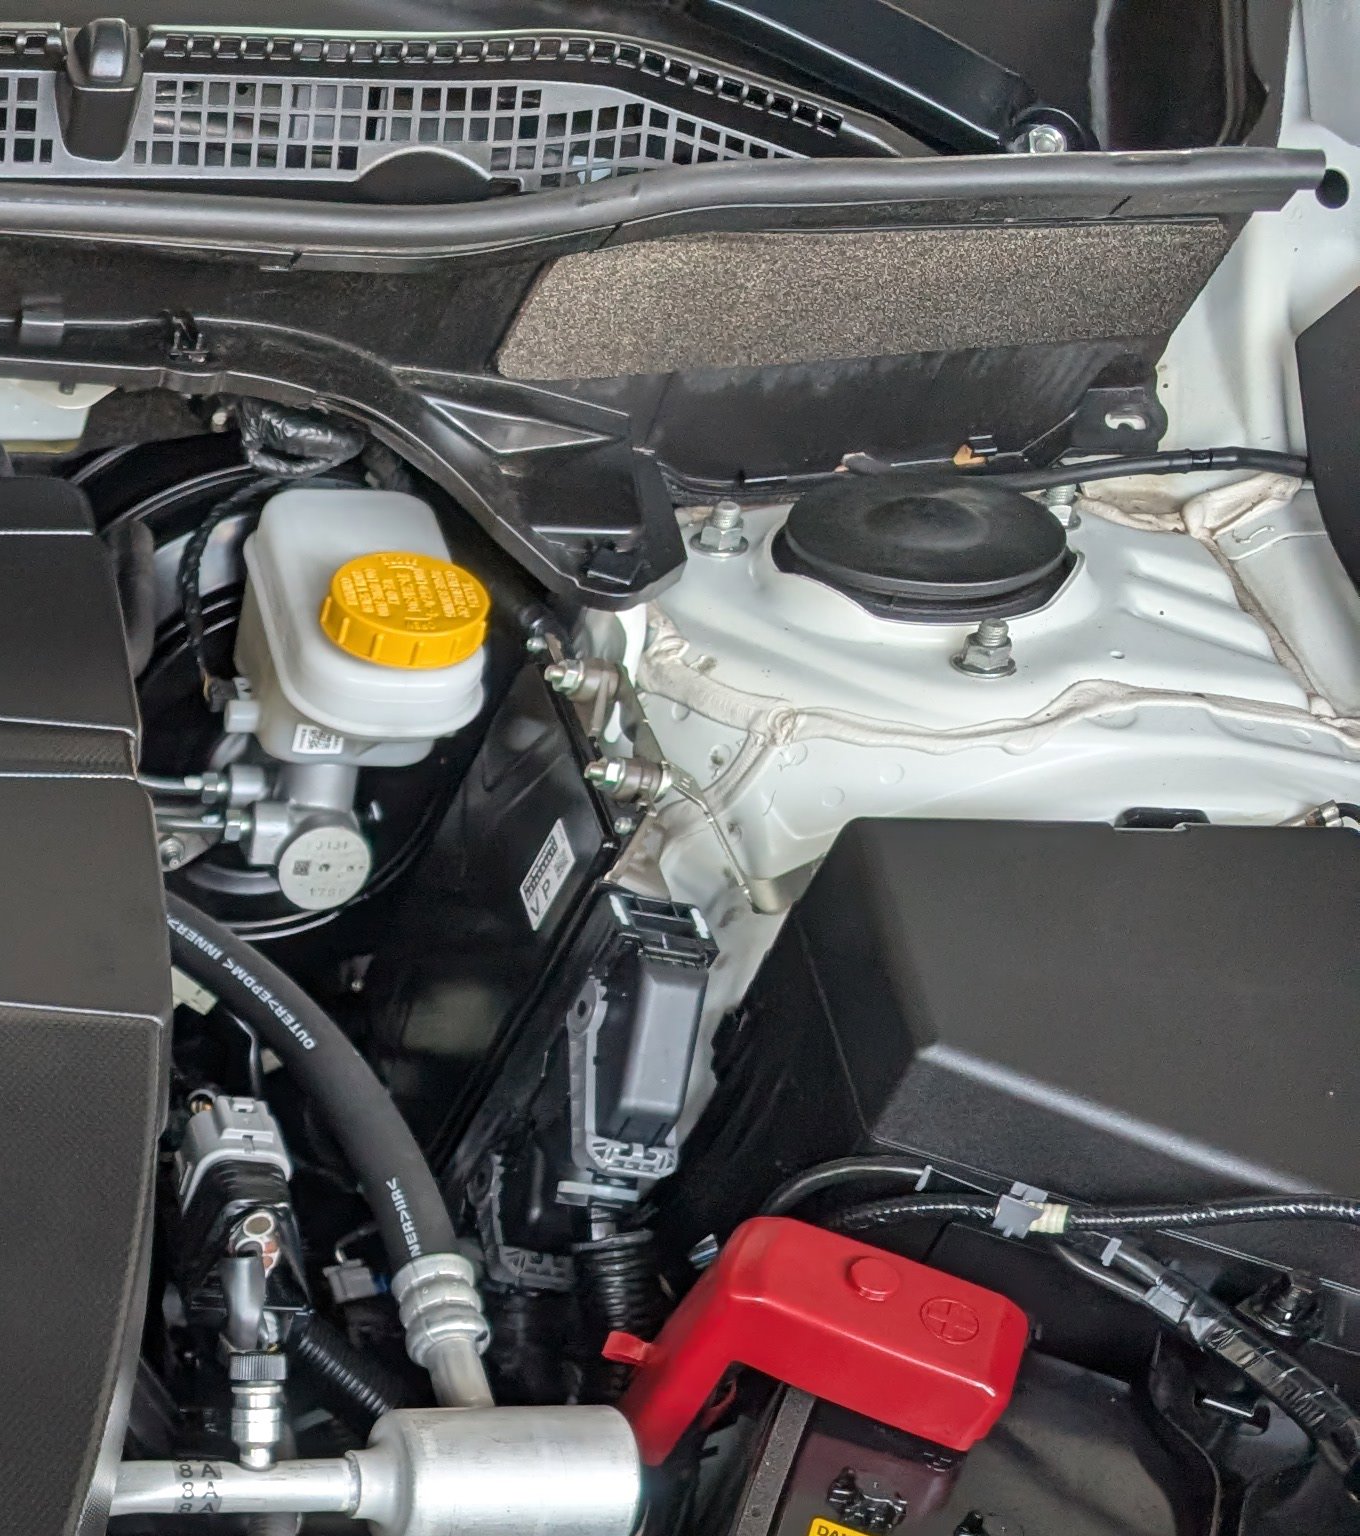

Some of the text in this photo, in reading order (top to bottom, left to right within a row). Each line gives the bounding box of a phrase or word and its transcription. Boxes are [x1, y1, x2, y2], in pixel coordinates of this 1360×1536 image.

[178, 1463, 218, 1478] 8 A
[181, 1480, 218, 1499] 8 A
